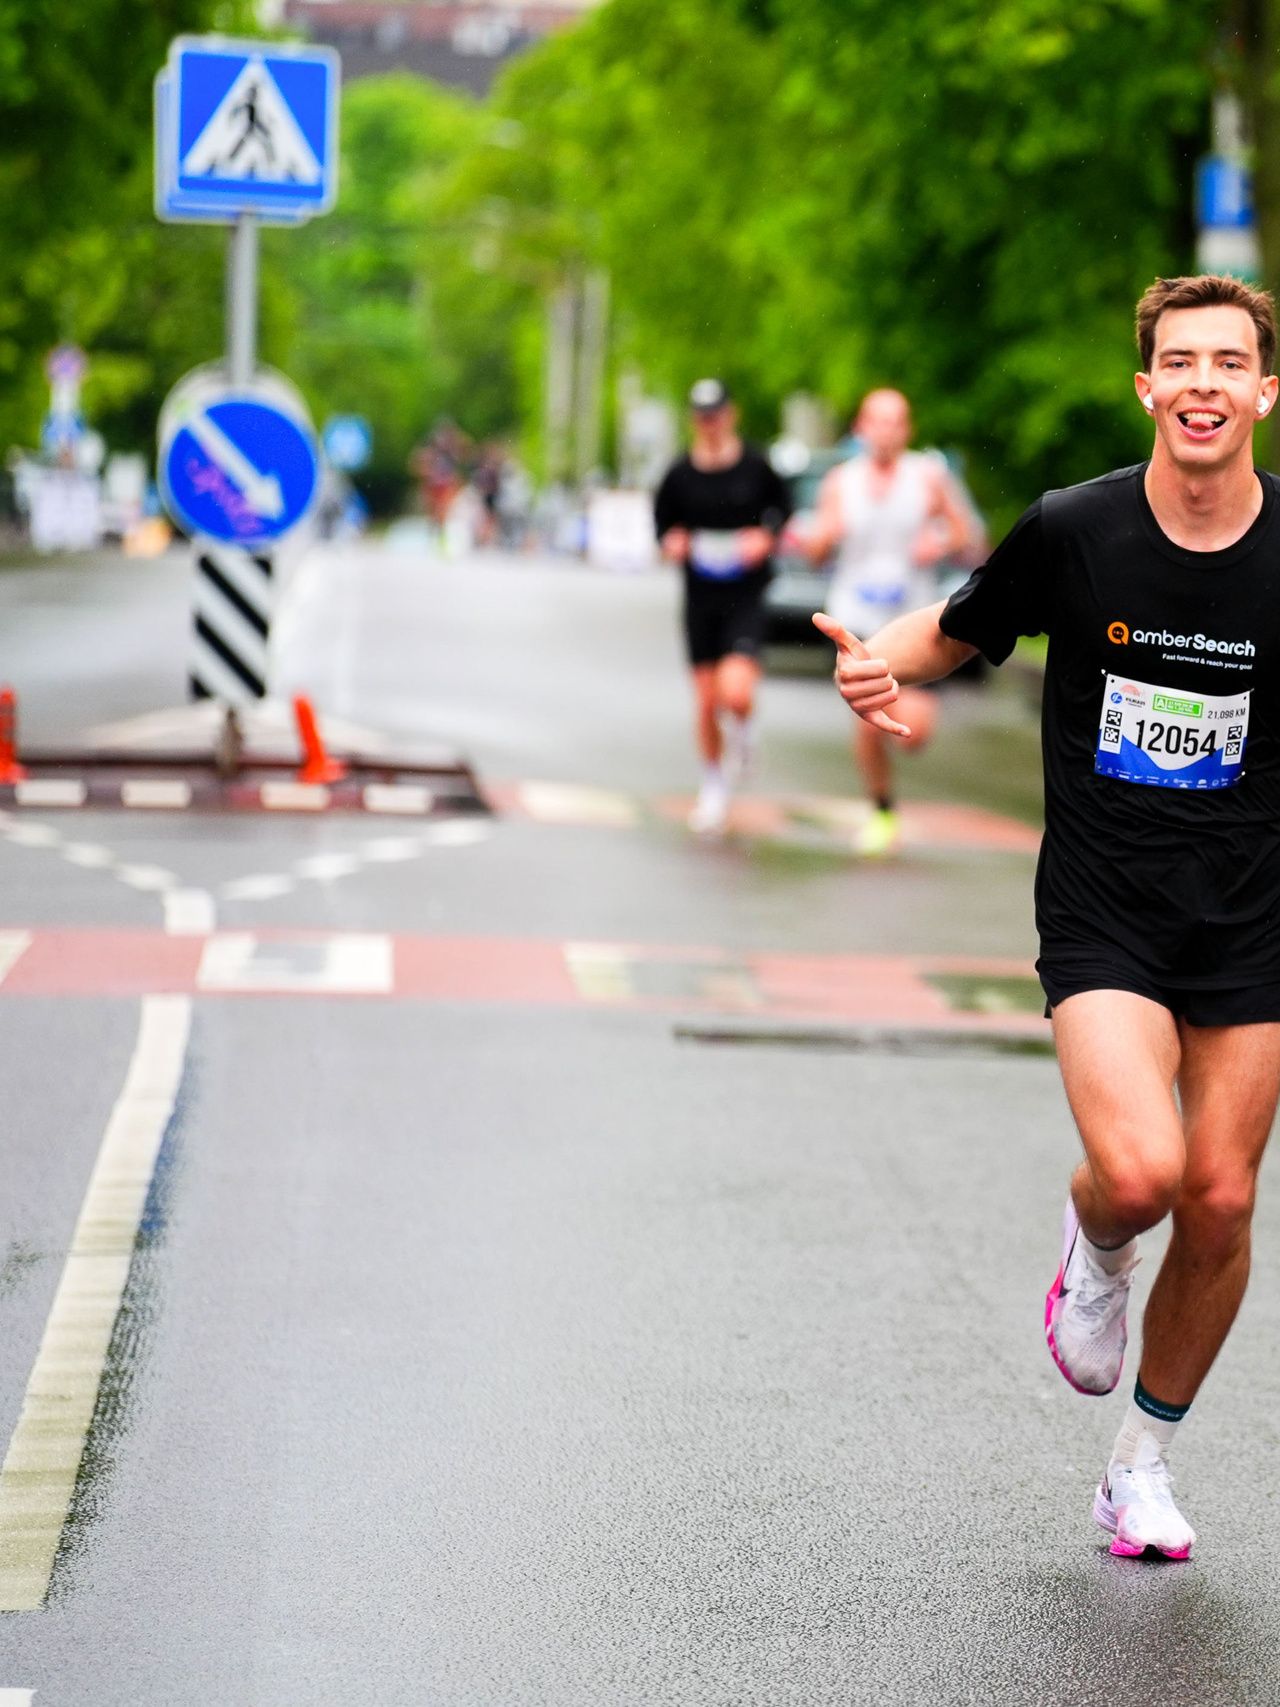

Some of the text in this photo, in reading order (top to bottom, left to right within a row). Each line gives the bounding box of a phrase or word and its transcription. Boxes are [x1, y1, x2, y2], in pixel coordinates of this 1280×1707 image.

[1132, 629, 1255, 656] amberSearch
[1162, 653, 1176, 661] Fast
[1176, 654, 1200, 664] forward
[1235, 708, 1246, 717] KM
[1136, 720, 1217, 757] 12054
